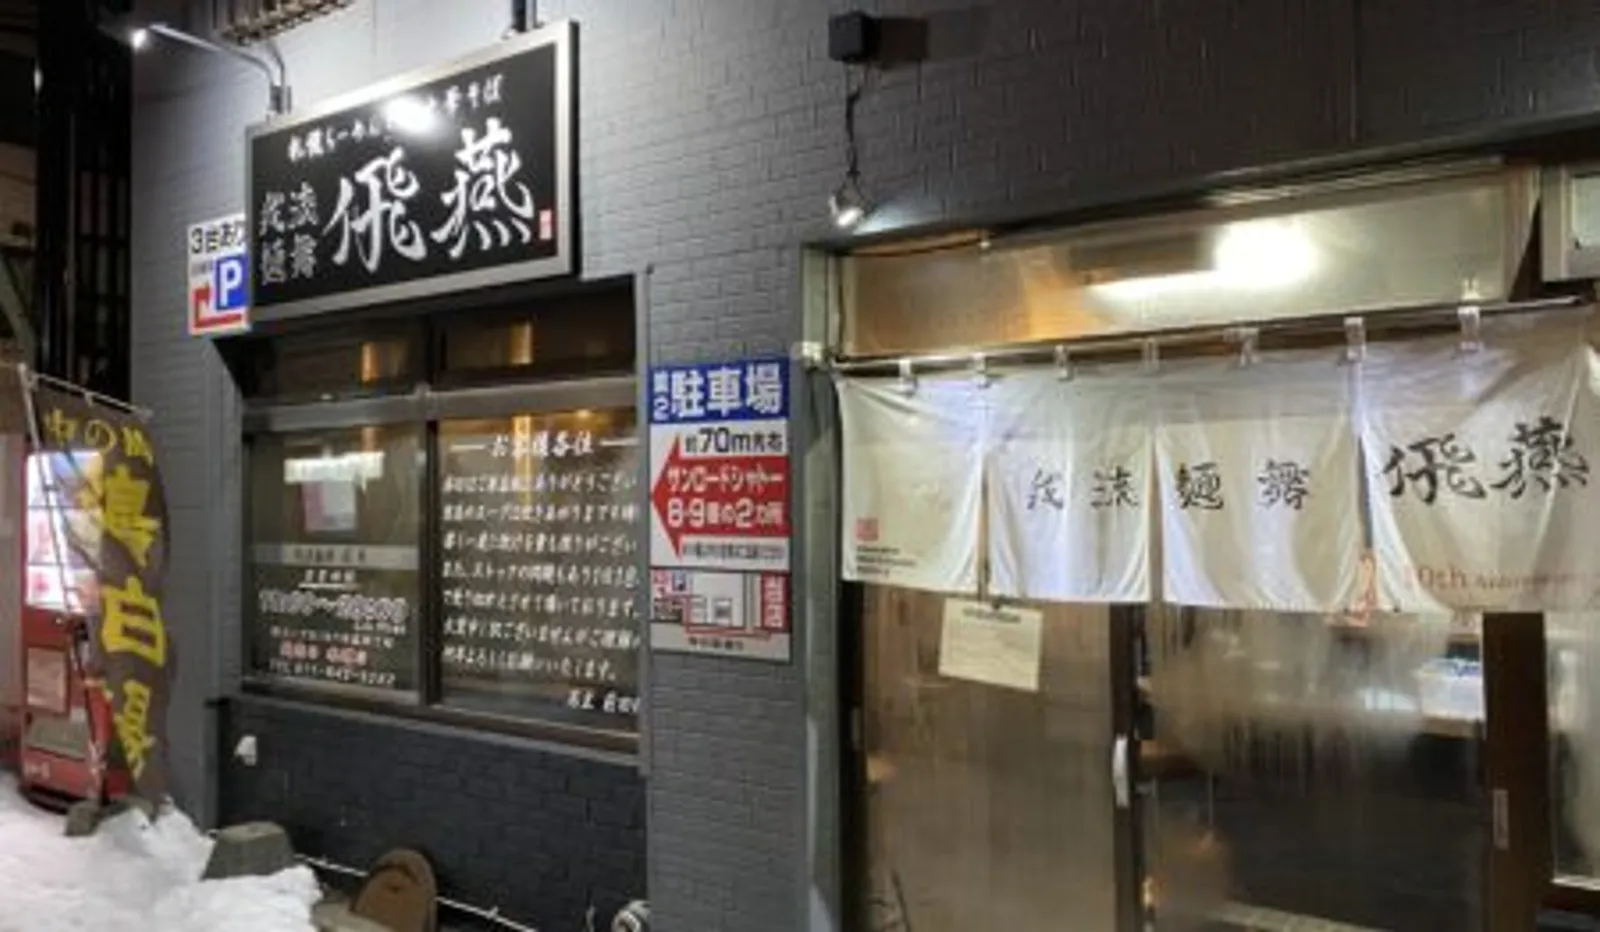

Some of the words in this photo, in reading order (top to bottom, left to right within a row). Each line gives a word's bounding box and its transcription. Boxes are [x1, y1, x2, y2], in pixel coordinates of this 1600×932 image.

[322, 118, 534, 272] 飛燕
[220, 258, 243, 306] P
[670, 361, 783, 418] 駐車場
[1382, 415, 1591, 506] 飛燕
